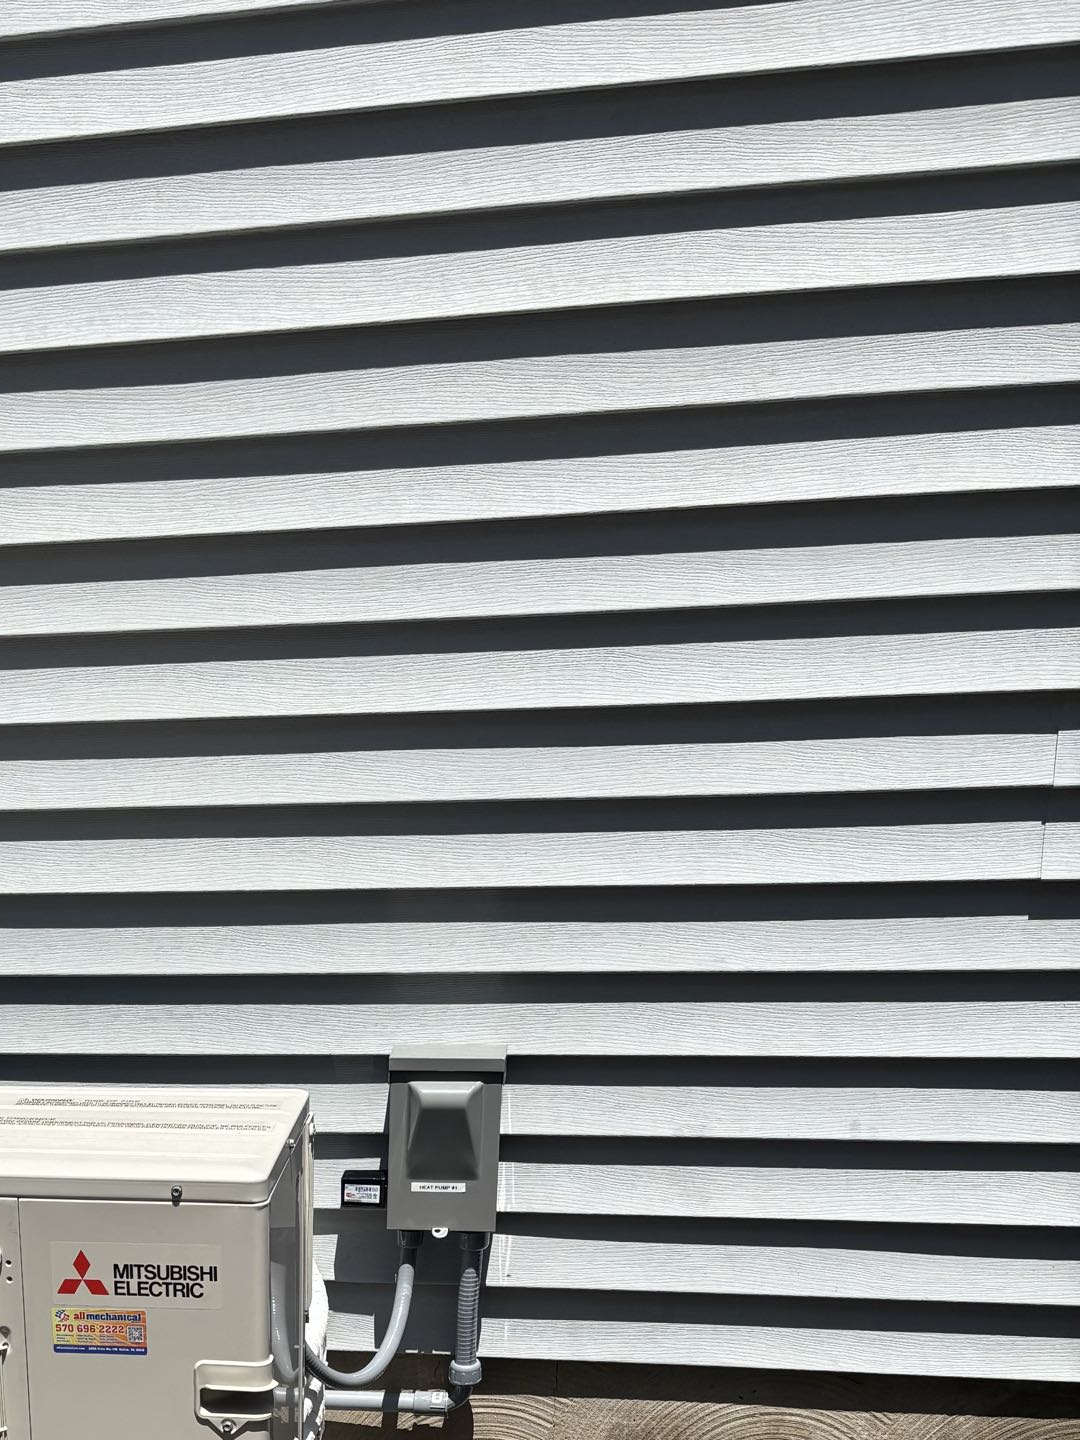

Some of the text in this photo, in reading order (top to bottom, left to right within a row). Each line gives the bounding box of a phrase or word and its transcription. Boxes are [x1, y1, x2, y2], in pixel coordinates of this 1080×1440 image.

[113, 1263, 218, 1282] MITSUBISHI
[113, 1281, 204, 1299] ELECTRIC
[55, 1323, 124, 1334] 570 696 2222
